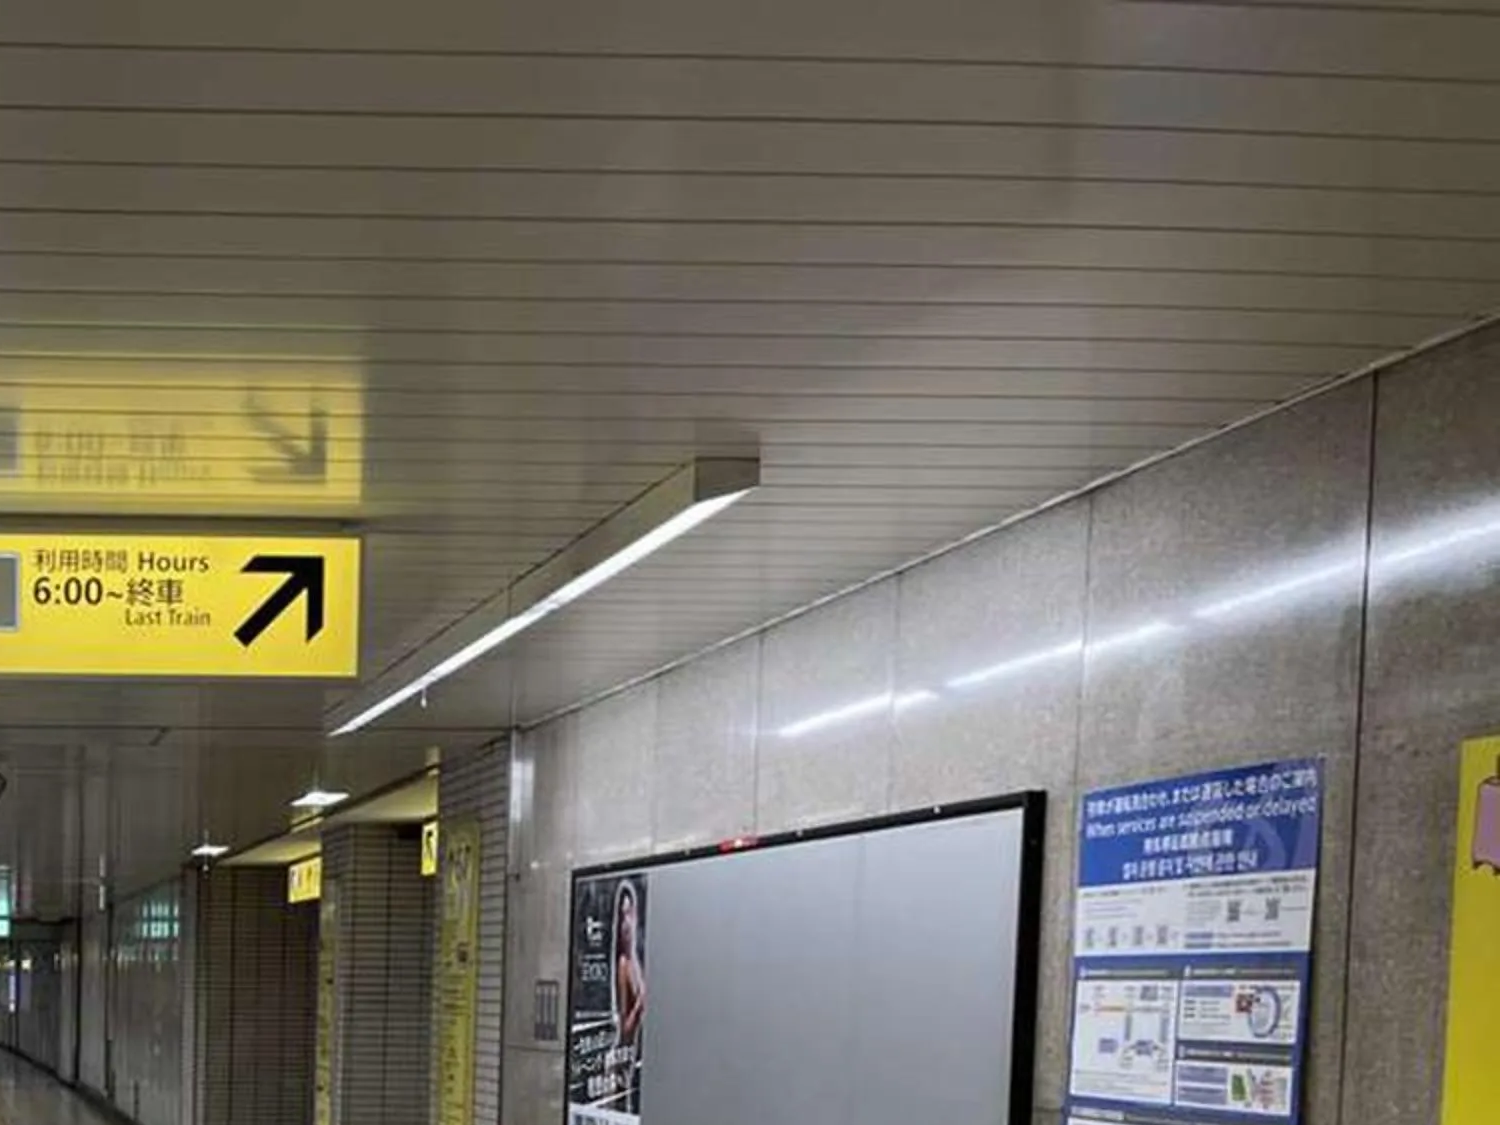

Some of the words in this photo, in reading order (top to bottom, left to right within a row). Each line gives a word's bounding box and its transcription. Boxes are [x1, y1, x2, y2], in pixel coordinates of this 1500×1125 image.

[34, 549, 128, 573] 利用時間
[137, 552, 209, 573] Hours
[125, 608, 161, 627] Last
[168, 608, 211, 627] Train
